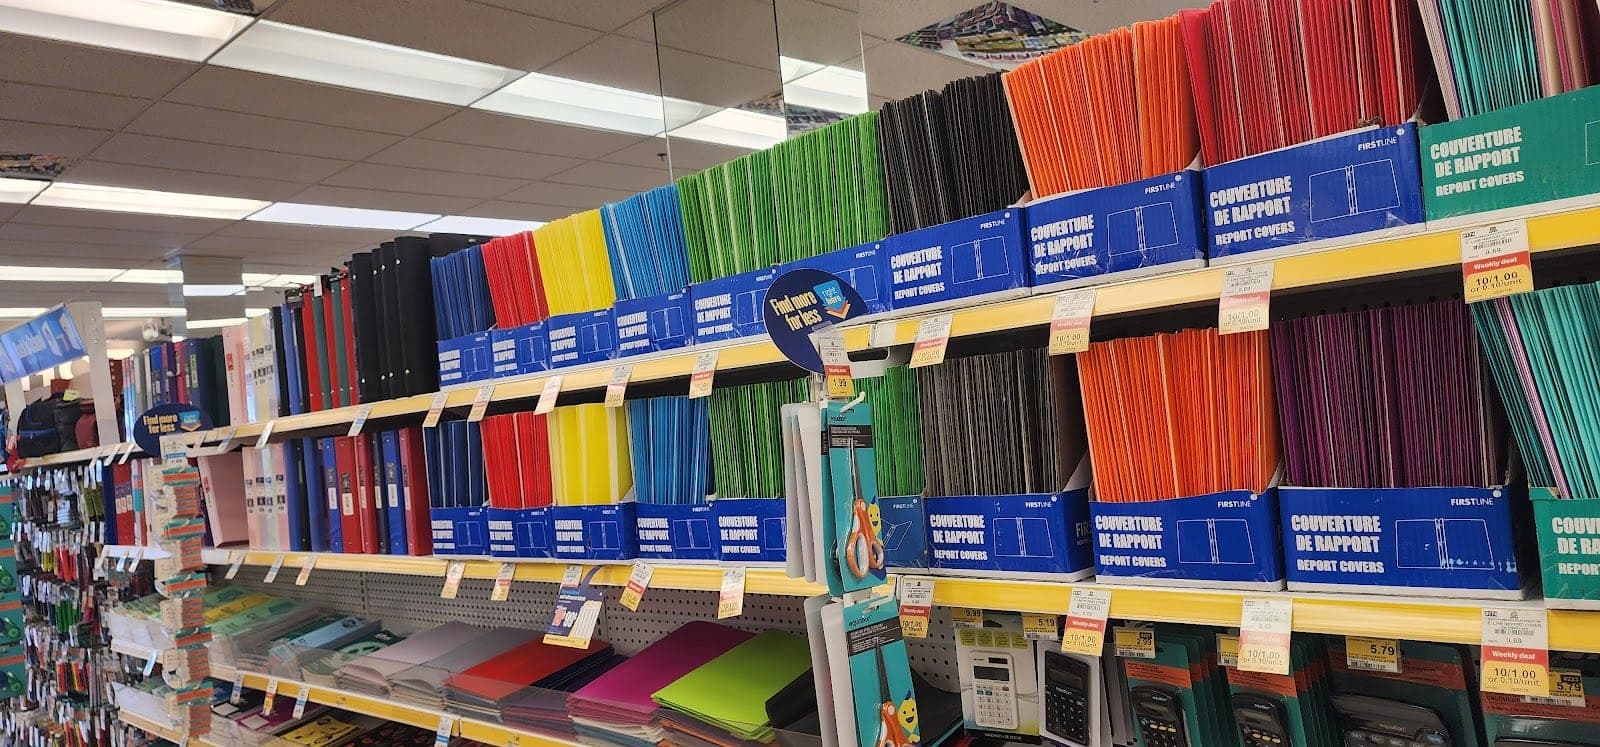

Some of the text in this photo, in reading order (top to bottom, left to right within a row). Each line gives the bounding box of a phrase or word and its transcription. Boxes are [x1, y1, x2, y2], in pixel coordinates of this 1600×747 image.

[1357, 137, 1398, 151] FIRSTLINE
[1430, 126, 1522, 160] COUVERTURE
[1435, 146, 1521, 178] DE RAPPORT
[1145, 182, 1176, 195] FIRSTLINE
[1209, 175, 1292, 207] COUVERTURE
[1436, 170, 1525, 198] REPORT COVERS
[1214, 196, 1291, 226] DE RAPPORT
[1031, 214, 1095, 241] COUVERTURE
[1215, 221, 1295, 246] REPORT COVERS
[1034, 233, 1093, 258] DE RAPPORT
[891, 245, 942, 269] COUVERTURE
[1474, 257, 1518, 270] Weekly deal
[1036, 255, 1097, 275] REPORT COVERS
[893, 262, 942, 284] DE RAPPORT
[1475, 271, 1518, 286] 10/1.00
[822, 286, 838, 298] right
[895, 281, 945, 300] REPORT COVERS
[769, 291, 817, 316] Find more
[785, 309, 822, 331] for less
[1025, 501, 1053, 509] FIRSTLINE
[1218, 500, 1252, 508] FIRSTLINE
[1451, 496, 1494, 507] FIRSTLINE
[930, 514, 986, 529] COUVERTURE
[1095, 515, 1163, 532] COUVERTURE
[1291, 514, 1382, 532] COUVERTURE
[933, 531, 985, 545] DE RAPPORT
[1098, 533, 1162, 550] DE RAPPORT
[1296, 534, 1380, 553] DE RAPPORT
[1557, 537, 1578, 554] DE
[934, 549, 987, 561] REPORT COVERS
[1100, 555, 1166, 567] REPORT COVERS
[1297, 558, 1385, 573] REPORT COVERS
[1038, 618, 1055, 626] 5.19
[1071, 634, 1096, 644] 10/1.00
[1248, 649, 1280, 660] 10/1.00
[1370, 644, 1395, 656] 5.79
[1491, 651, 1536, 661] Weekly deal
[1493, 668, 1537, 680] 10/1.00
[1557, 682, 1581, 691] 5.79
